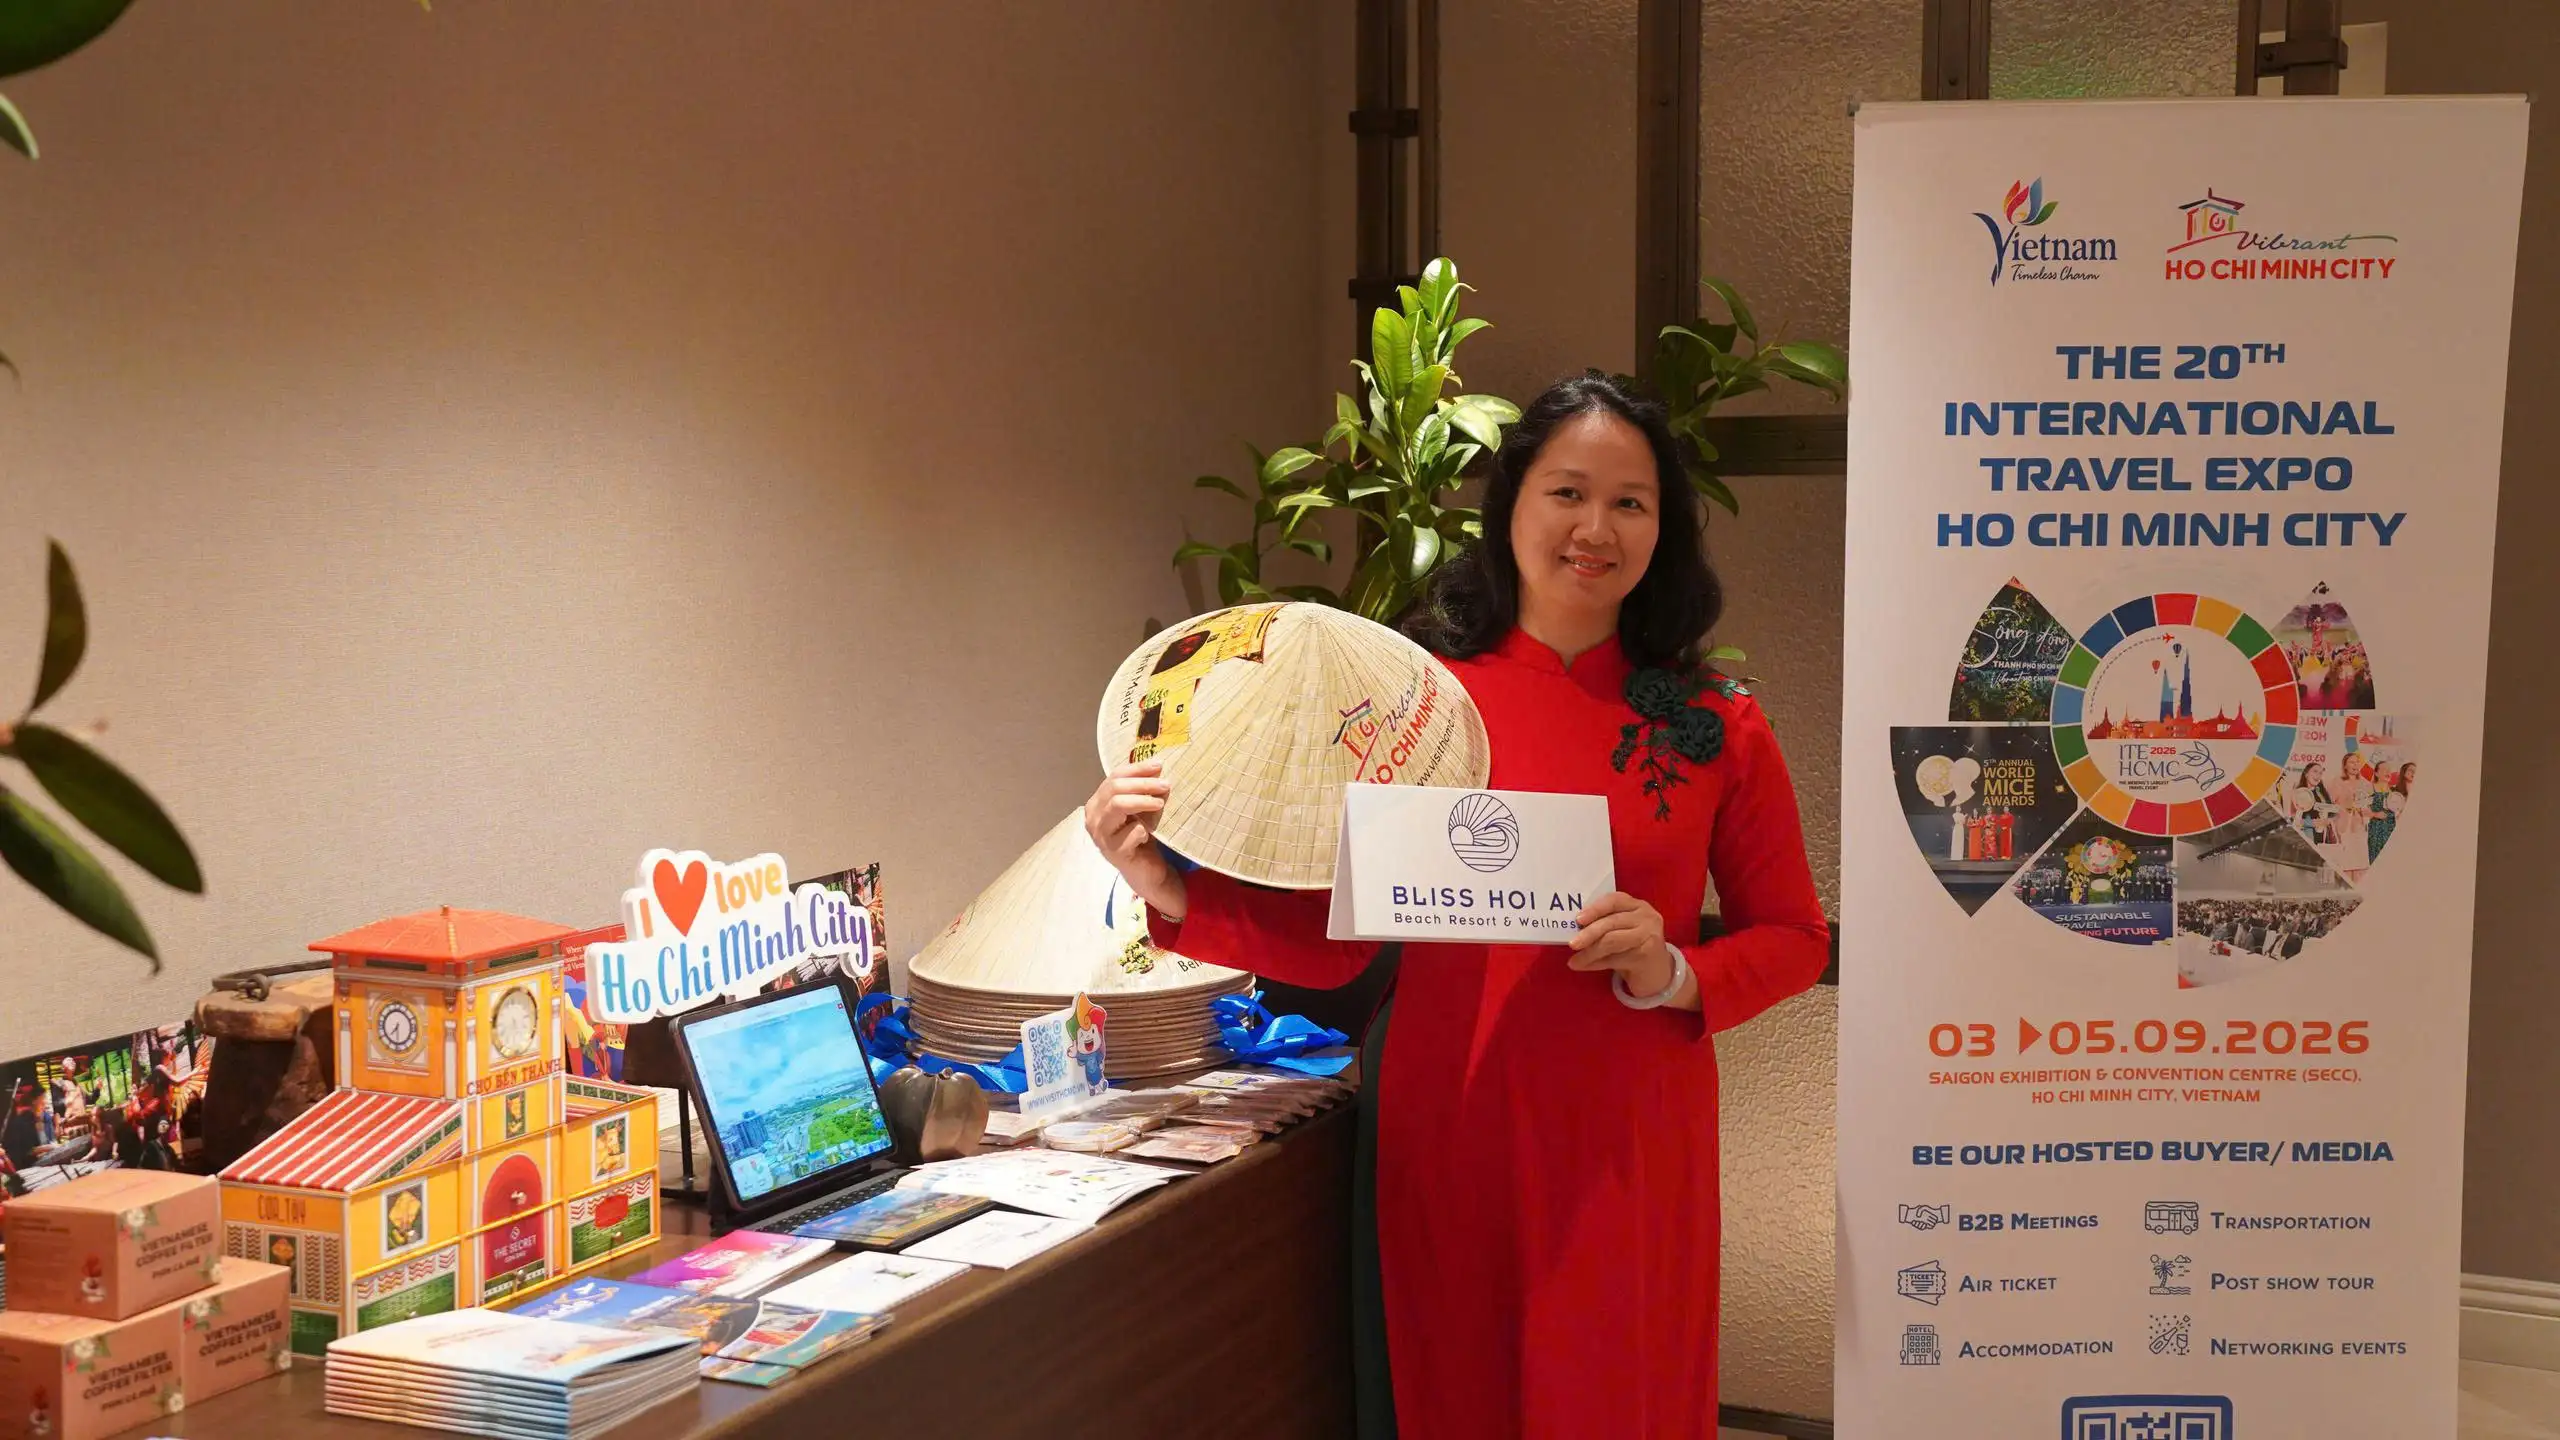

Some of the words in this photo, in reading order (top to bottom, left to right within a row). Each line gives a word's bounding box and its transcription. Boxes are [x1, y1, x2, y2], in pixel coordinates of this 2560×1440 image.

[1972, 212, 2118, 288] Vietnam
[2237, 231, 2397, 251] Vibrant
[2011, 264, 2057, 281] Timeless
[2060, 266, 2100, 281] Charm
[2165, 259, 2206, 280] HO
[2210, 259, 2256, 280] CHI
[2261, 258, 2327, 280] MINH
[2330, 258, 2397, 279] CITY
[2056, 345, 2161, 380] THE
[2174, 343, 2285, 380] 20TH
[1945, 401, 2395, 436] INTERNATIONAL
[1979, 457, 2192, 491] TRAVEL
[2205, 457, 2353, 491] EXPO
[1937, 513, 2014, 547] HO
[2028, 513, 2108, 547] CHI
[2122, 512, 2269, 547] MINH
[2283, 513, 2407, 547] CITY
[1391, 728, 1418, 767] CHI
[1409, 688, 1436, 737] MINH
[2119, 744, 2148, 760] ITE
[2150, 746, 2177, 755] 2026
[1983, 767, 2036, 778] WORLD
[2119, 760, 2180, 777] HCMC
[1983, 779, 2035, 795] MICE
[1982, 796, 2035, 806] AWARDS
[640, 898, 653, 938] I
[714, 862, 782, 913] love
[1392, 886, 1474, 908] BLISS
[1489, 889, 1536, 910] HOI
[1549, 892, 1583, 911] AN
[1395, 913, 1441, 925] Beach
[1449, 915, 1497, 927] Resort
[1504, 916, 1512, 927] &
[1519, 916, 1579, 929] Wellnes
[2056, 912, 2152, 921] SUSTAINABLE
[2104, 928, 2159, 936] FUTURE
[602, 953, 650, 1014] Ho
[657, 943, 715, 1005] Chi
[720, 901, 807, 986] Minh
[809, 893, 868, 969] City
[1929, 1023, 1995, 1057] 03
[2049, 1020, 2369, 1055] 05.09.2026
[1929, 1071, 1994, 1084] SAIGON
[2000, 1069, 2091, 1083] EXHIBITION
[2096, 1068, 2107, 1080] &
[2113, 1068, 2223, 1081] CONVENTION
[2229, 1068, 2297, 1081] CENTRE
[2032, 1091, 2054, 1104] HO
[2059, 1090, 2085, 1103] CHI
[2090, 1088, 2132, 1102] MINH
[2182, 1089, 2260, 1102] VIETNAM
[1913, 1145, 1953, 1165] BE
[1960, 1144, 2025, 1165] OUR
[2032, 1141, 2154, 1163] HOSTED
[2292, 1141, 2394, 1162] MEDIA
[1959, 1214, 2004, 1231] B2B
[140, 1222, 208, 1252] VIETNAMESE
[136, 1246, 177, 1268] COFFEE
[180, 1233, 213, 1250] FILTER
[2000, 1277, 2057, 1292] TICKET
[2267, 1277, 2320, 1290] SHOW
[2327, 1277, 2375, 1290] TOUR
[205, 1310, 277, 1342] VIETNAMESE
[199, 1335, 243, 1357] COFFEE
[246, 1320, 282, 1341] FILTER
[2342, 1342, 2407, 1355] EVENTS
[89, 1352, 168, 1385] VIETNAMESE
[83, 1378, 130, 1400] COFFEE
[134, 1361, 173, 1383] FILTER
